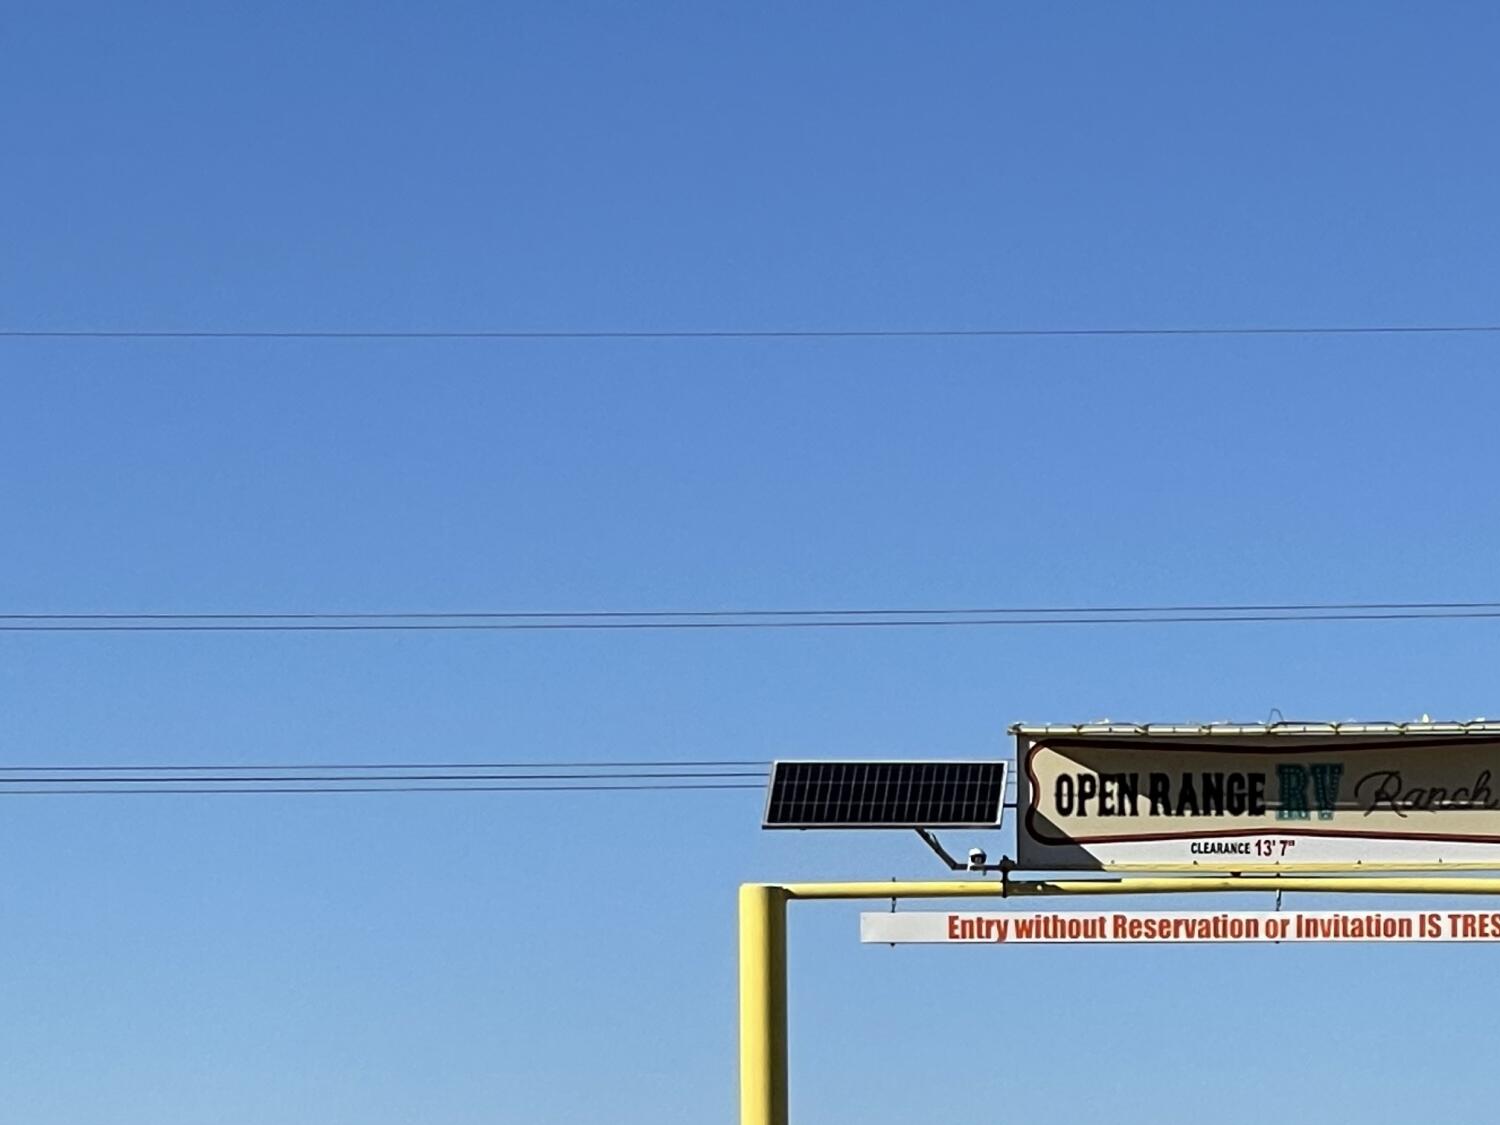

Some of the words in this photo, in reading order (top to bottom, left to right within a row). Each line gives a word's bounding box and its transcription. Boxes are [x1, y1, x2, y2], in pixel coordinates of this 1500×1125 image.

[1056, 773, 1139, 816] OPEN
[1149, 773, 1266, 816] RANGE
[1276, 764, 1344, 821] RV
[1354, 769, 1499, 818] Ranch
[1191, 842, 1251, 855] CLEARANCE
[1255, 839, 1276, 857] 13'
[1279, 839, 1296, 857] 7"
[948, 915, 1008, 942] Entry
[1014, 915, 1107, 940] without
[1112, 914, 1258, 940] Reservation
[1264, 919, 1290, 939] or
[1296, 914, 1412, 938] Invitation
[1419, 914, 1440, 938] IS
